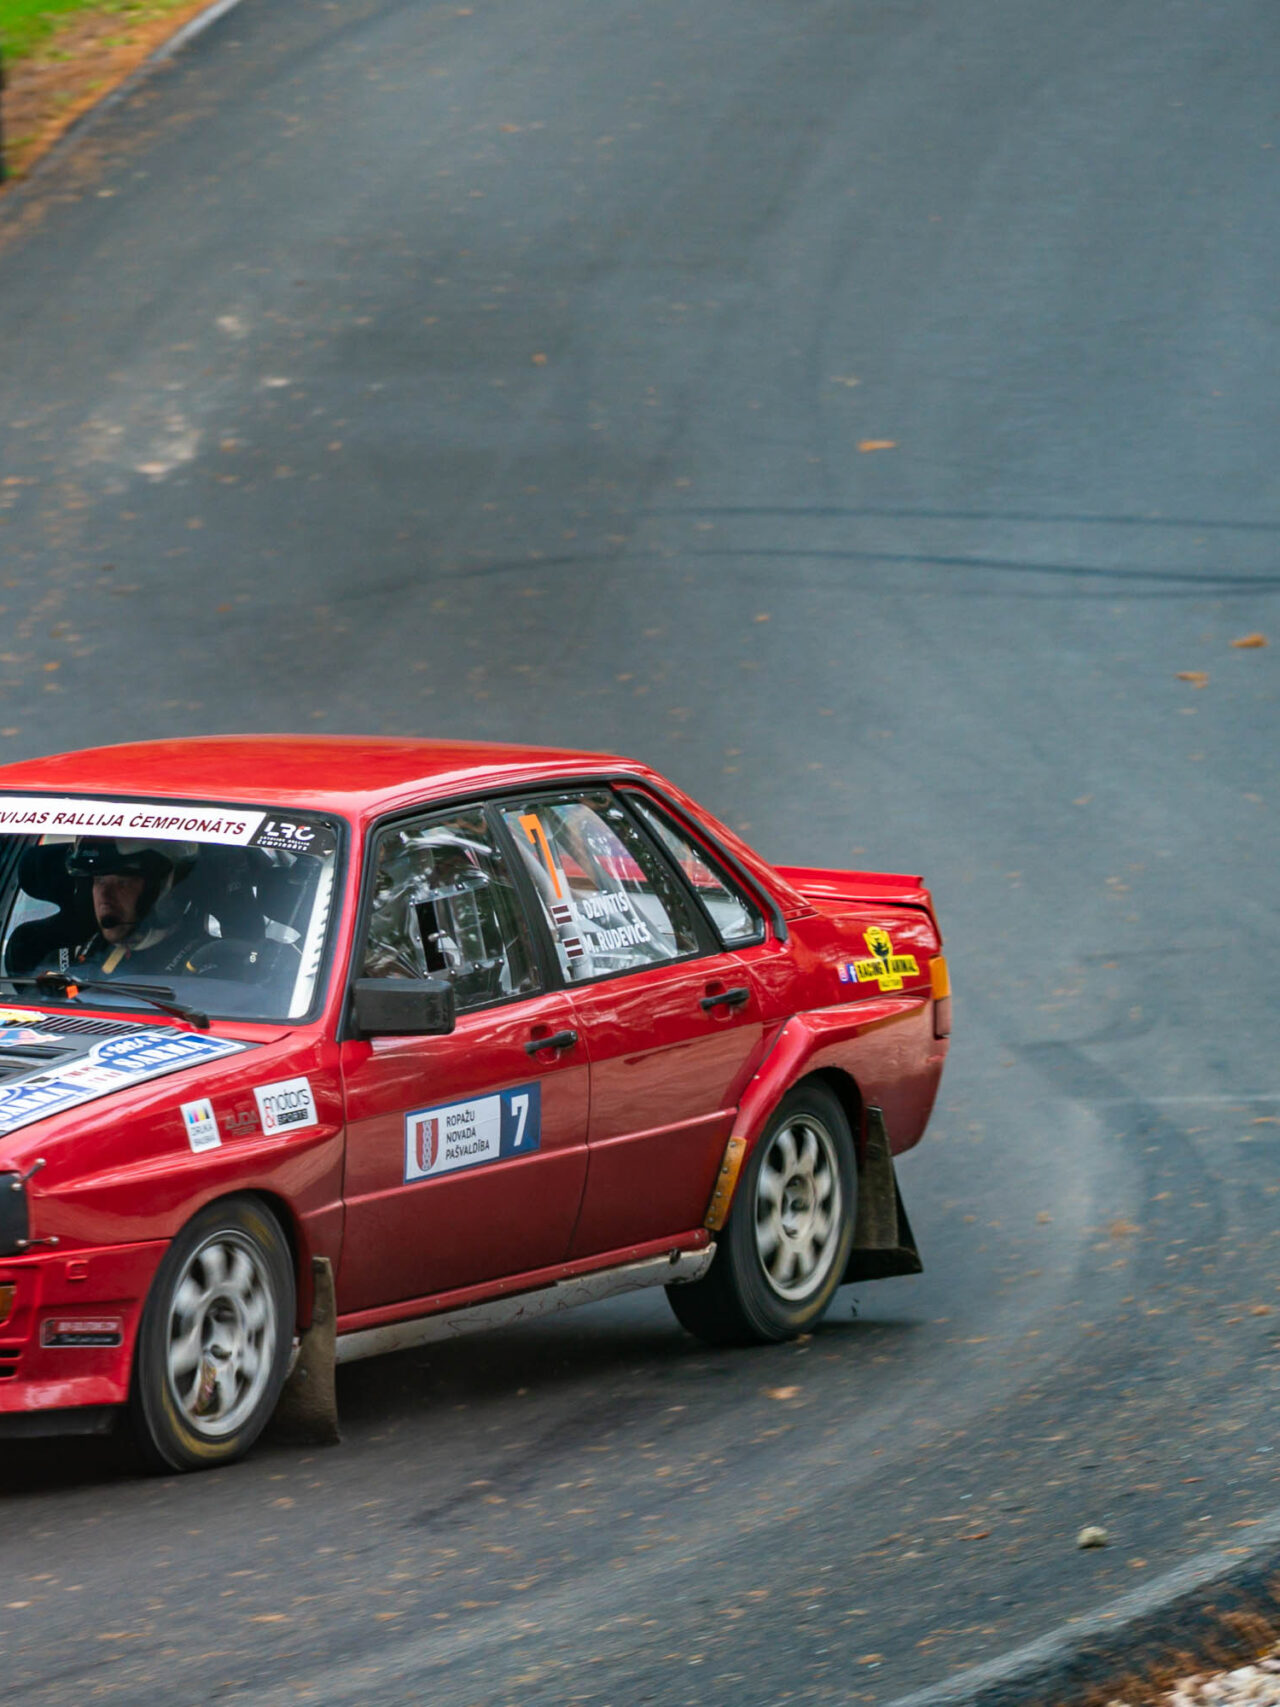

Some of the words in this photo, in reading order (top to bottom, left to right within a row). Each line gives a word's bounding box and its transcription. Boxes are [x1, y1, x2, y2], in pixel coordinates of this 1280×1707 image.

[52, 811, 126, 829] RALLIJA
[130, 811, 248, 837] ČEMPIONĀTS
[518, 813, 563, 899] 7
[596, 918, 651, 951] RUDEVIČS
[111, 1040, 214, 1070] SARMA
[263, 1088, 311, 1113] motors
[278, 1109, 309, 1125] SPORTS
[445, 1109, 476, 1127] ROPAŽU
[510, 1094, 530, 1148] 7
[445, 1128, 478, 1142] NOVADA
[445, 1140, 491, 1160] PAŠVALDĪBA
